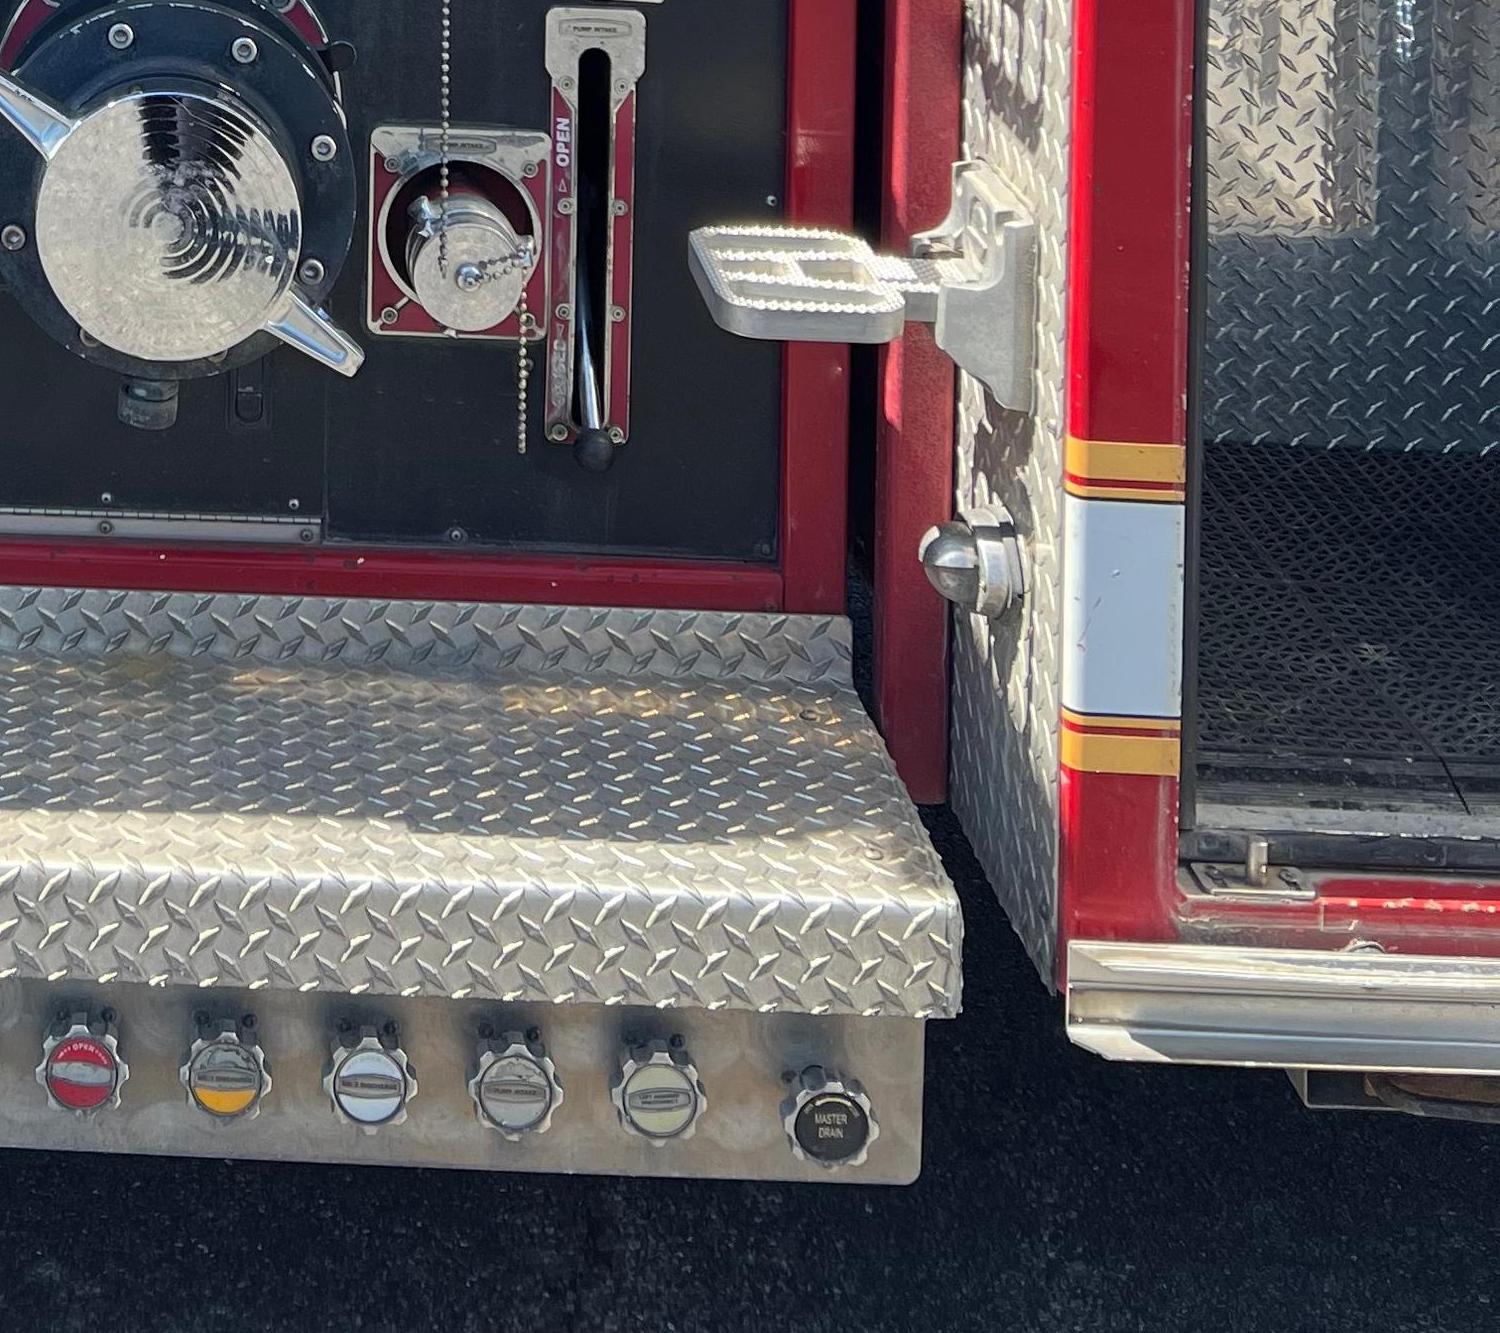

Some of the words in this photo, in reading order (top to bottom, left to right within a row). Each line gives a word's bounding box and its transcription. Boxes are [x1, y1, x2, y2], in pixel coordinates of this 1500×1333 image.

[556, 117, 570, 167] OPEN
[72, 1042, 95, 1053] OPEN
[814, 1113, 848, 1125] MASTER
[818, 1127, 844, 1139] DRAIN
